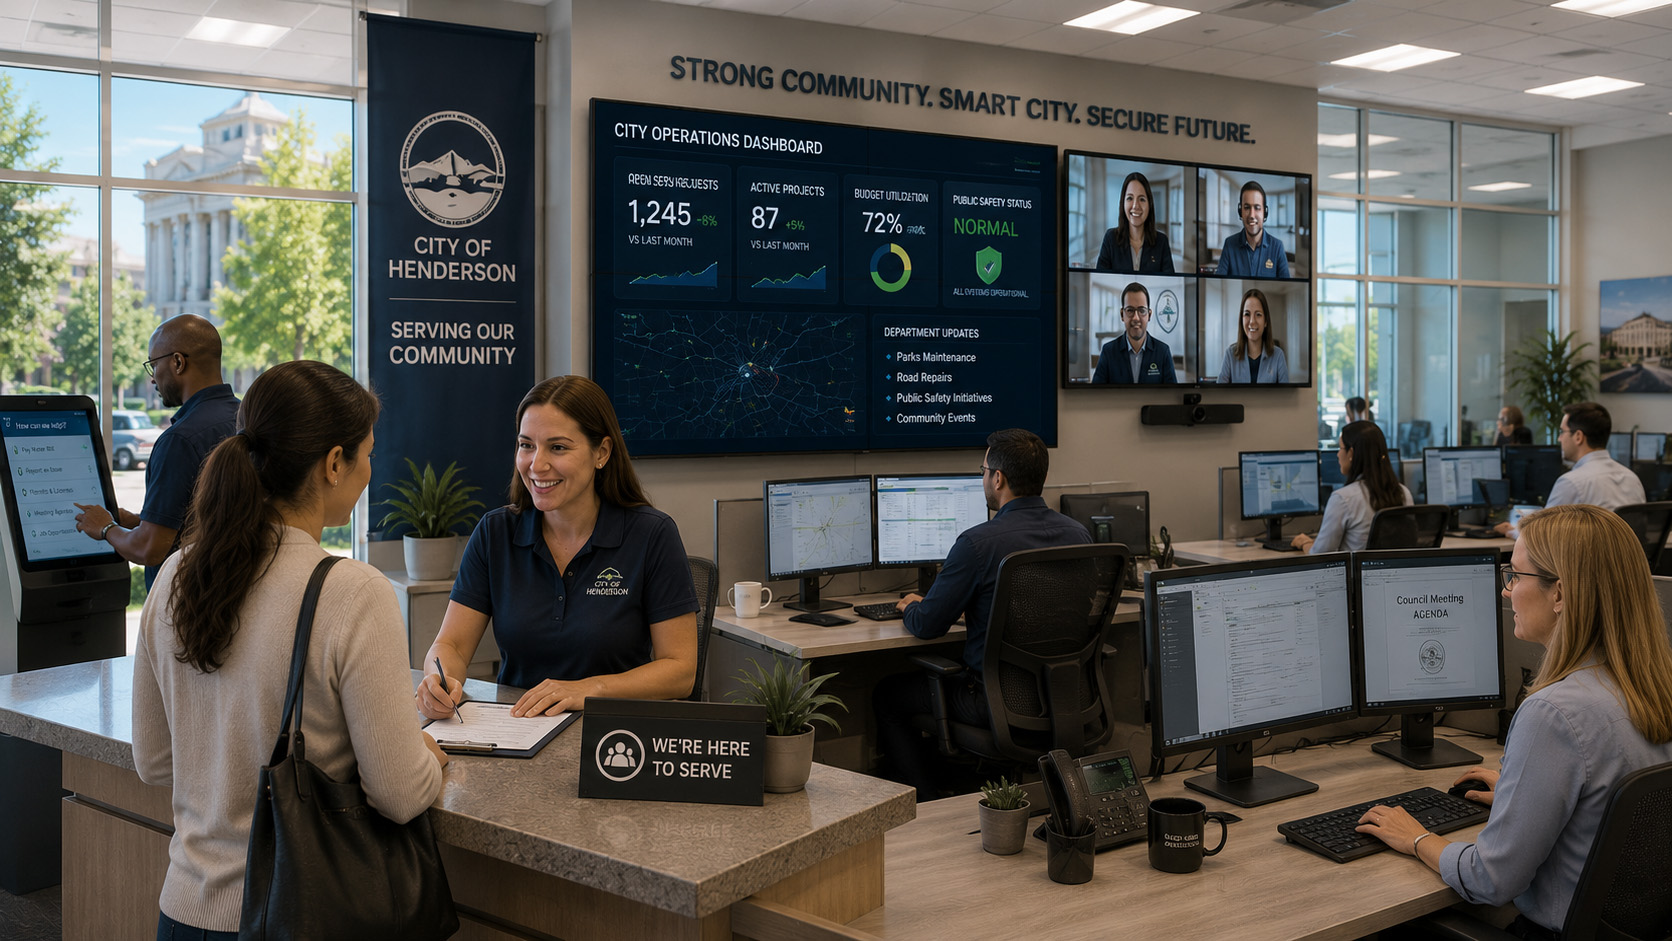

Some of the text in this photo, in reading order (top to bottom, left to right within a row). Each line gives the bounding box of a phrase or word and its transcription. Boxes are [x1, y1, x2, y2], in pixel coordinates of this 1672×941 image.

[670, 55, 1256, 145] STRONG COMMUNITY. SMART CITY. SECURE FUTURE.
[614, 122, 823, 155] CITY OPERATIONS DASHBOARD
[750, 182, 825, 197] ACTIVE PROJECTS
[854, 188, 884, 200] BUDGET
[953, 195, 1032, 209] PUBLIC SAFETY STATUS
[628, 199, 691, 228] 1,245
[751, 205, 779, 230] 87
[862, 211, 903, 234] 72%
[954, 217, 1019, 237] NORMAL
[414, 236, 492, 257] CITY OF
[628, 234, 693, 247] VS LAST MONTH
[750, 239, 810, 251] VS LAST MONTH
[388, 259, 516, 282] HENDERSON
[391, 321, 515, 340] SERVING OUR
[884, 327, 979, 339] DEPARTMENT UPDATES
[389, 345, 516, 365] COMMUNITY
[896, 352, 976, 362] Parks Maintenance
[896, 372, 953, 384] Road Repairs
[896, 393, 993, 405] Public Safety Initiatives
[896, 412, 976, 425] Community Events
[1396, 593, 1464, 605] Council Meeting
[1413, 609, 1449, 620] AGENDA
[652, 737, 751, 757] WE'RE HERE
[652, 760, 732, 779] TO SERVE
